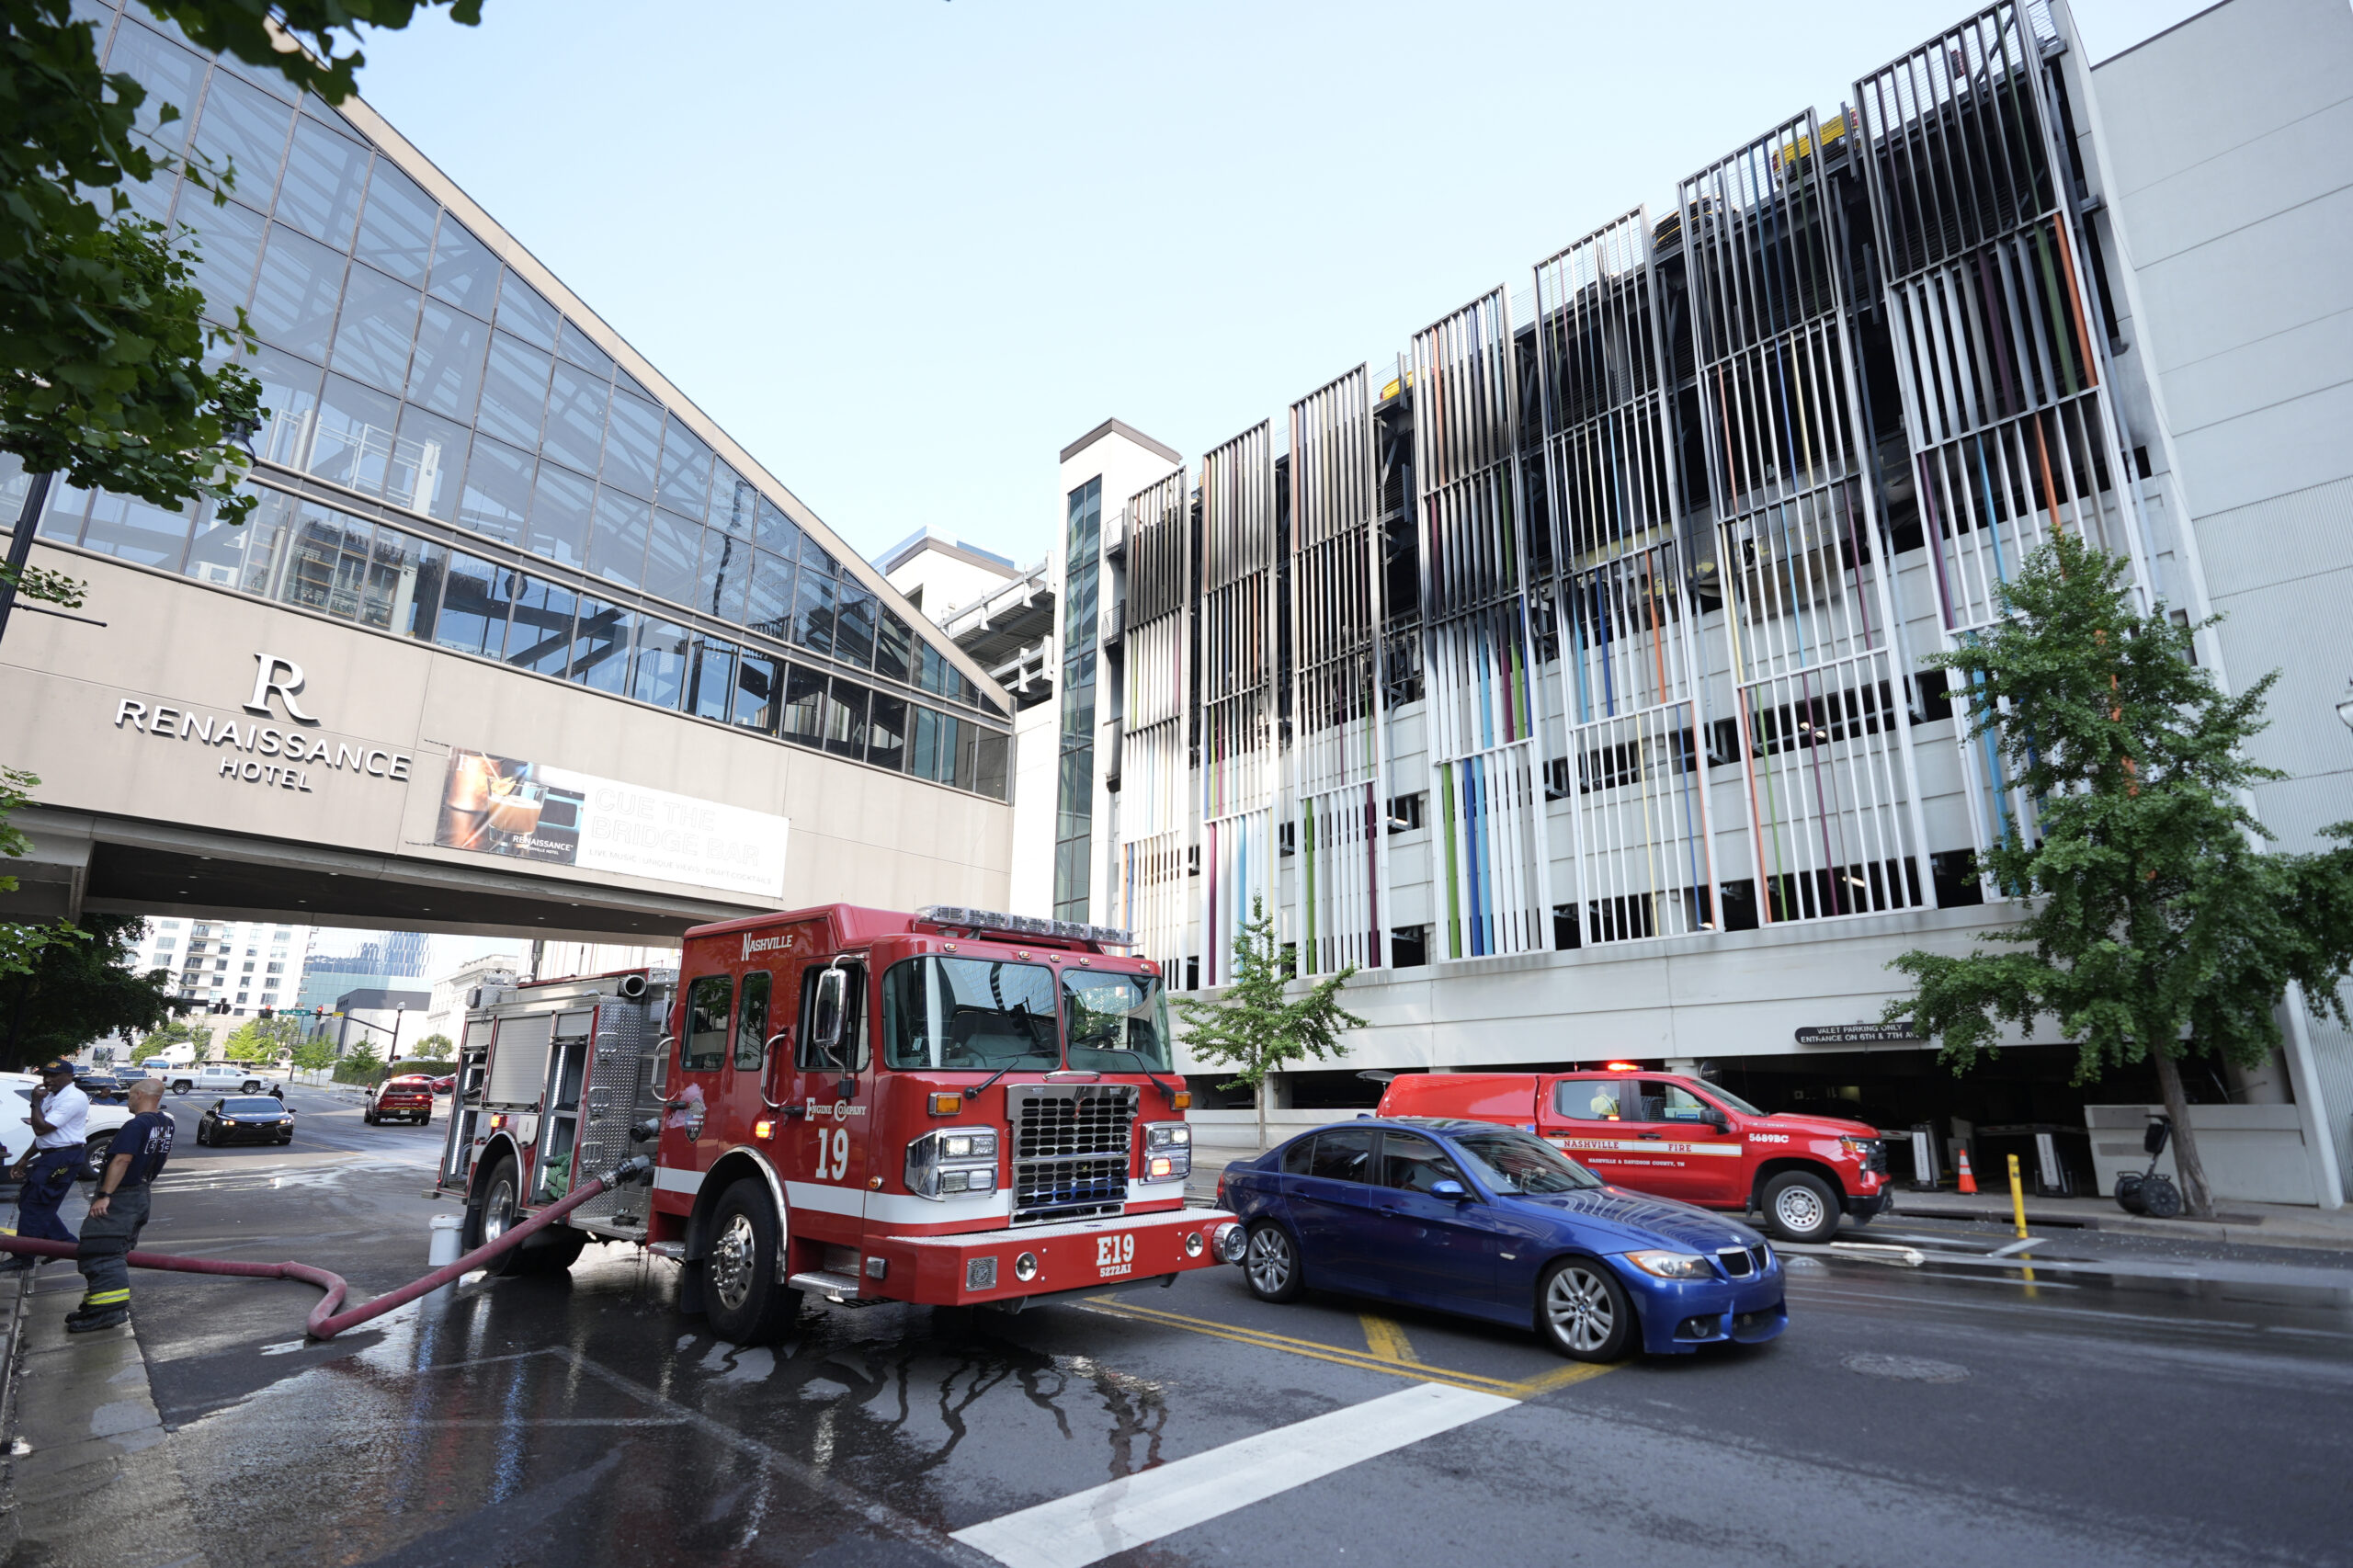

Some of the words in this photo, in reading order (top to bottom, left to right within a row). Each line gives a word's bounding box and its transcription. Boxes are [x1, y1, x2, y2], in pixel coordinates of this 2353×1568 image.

[243, 652, 321, 722] R
[114, 698, 412, 780] RENAISSANCE
[218, 756, 313, 792] HOTEL
[595, 788, 655, 821] CUE
[663, 801, 716, 832] THE
[512, 835, 571, 852] RENAISSANCE
[591, 815, 699, 856] BRIDGE
[706, 837, 760, 867] BAR
[588, 848, 608, 858] LIVE
[609, 851, 638, 863] MUSIC
[642, 858, 674, 869] UNIQUE
[676, 862, 701, 873] VIEWS
[705, 867, 730, 877] CRAFT
[731, 872, 772, 885] COCKTAILS
[741, 932, 793, 961] NASHVILLE
[1801, 1035, 1843, 1043] ENTRANCE
[1887, 1031, 1903, 1040] 7TH
[1843, 1024, 1879, 1033] PARKING
[1881, 1023, 1903, 1031] ONLY
[804, 1097, 833, 1121] ENGINE
[834, 1099, 867, 1122] COMPANY
[1563, 1140, 1620, 1150] NASHVILLE
[1668, 1143, 1692, 1153] FIRE
[1748, 1132, 1790, 1143] 5689BC
[815, 1127, 849, 1181] 19
[1096, 1233, 1134, 1267] E19
